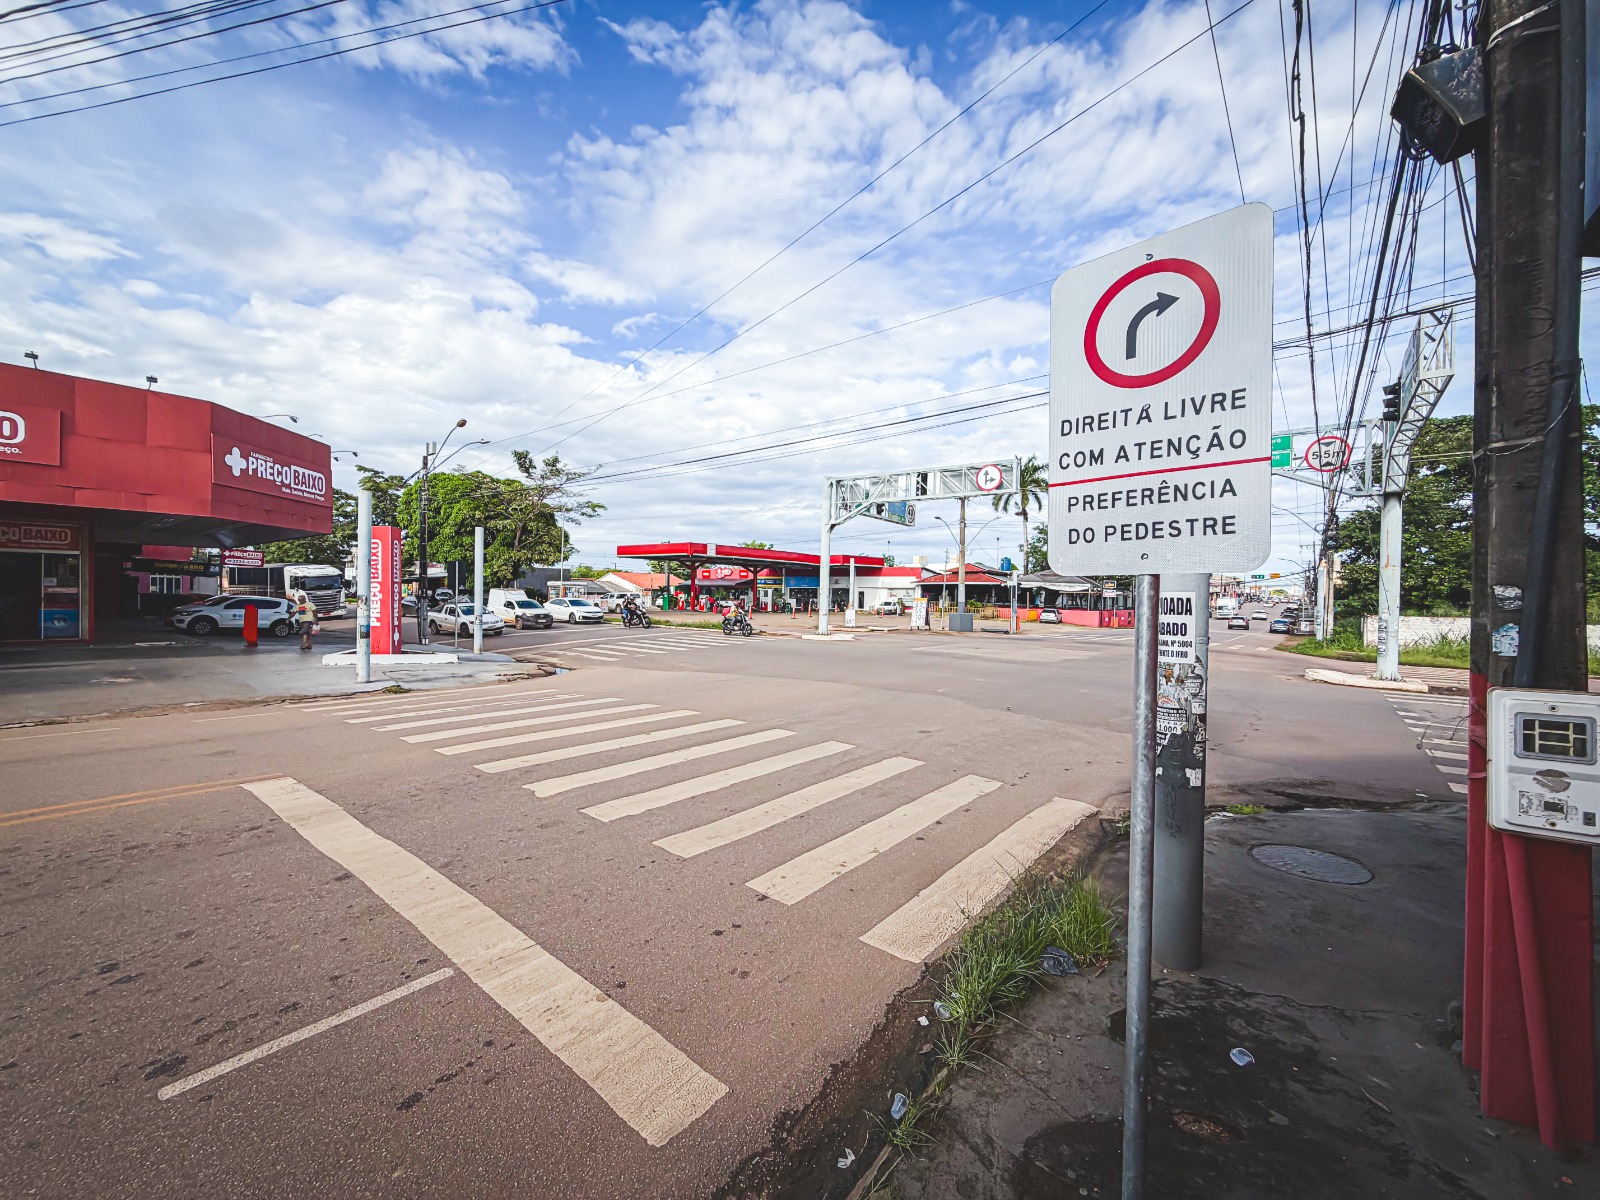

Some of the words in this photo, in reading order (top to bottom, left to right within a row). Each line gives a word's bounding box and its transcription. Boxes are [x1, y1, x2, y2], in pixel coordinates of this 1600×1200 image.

[1060, 404, 1153, 437] DIREITA
[1164, 387, 1247, 421] LIVRE
[1058, 447, 1105, 470] COM
[1114, 424, 1247, 464] ATENÇÃO
[248, 456, 291, 486] PREÇO
[293, 467, 325, 493] BAIXO
[1067, 478, 1238, 513] PREFERÊNCIA
[1068, 527, 1096, 545] DO
[1104, 515, 1237, 543] PEDESTRE
[1159, 622, 1188, 637] BADO
